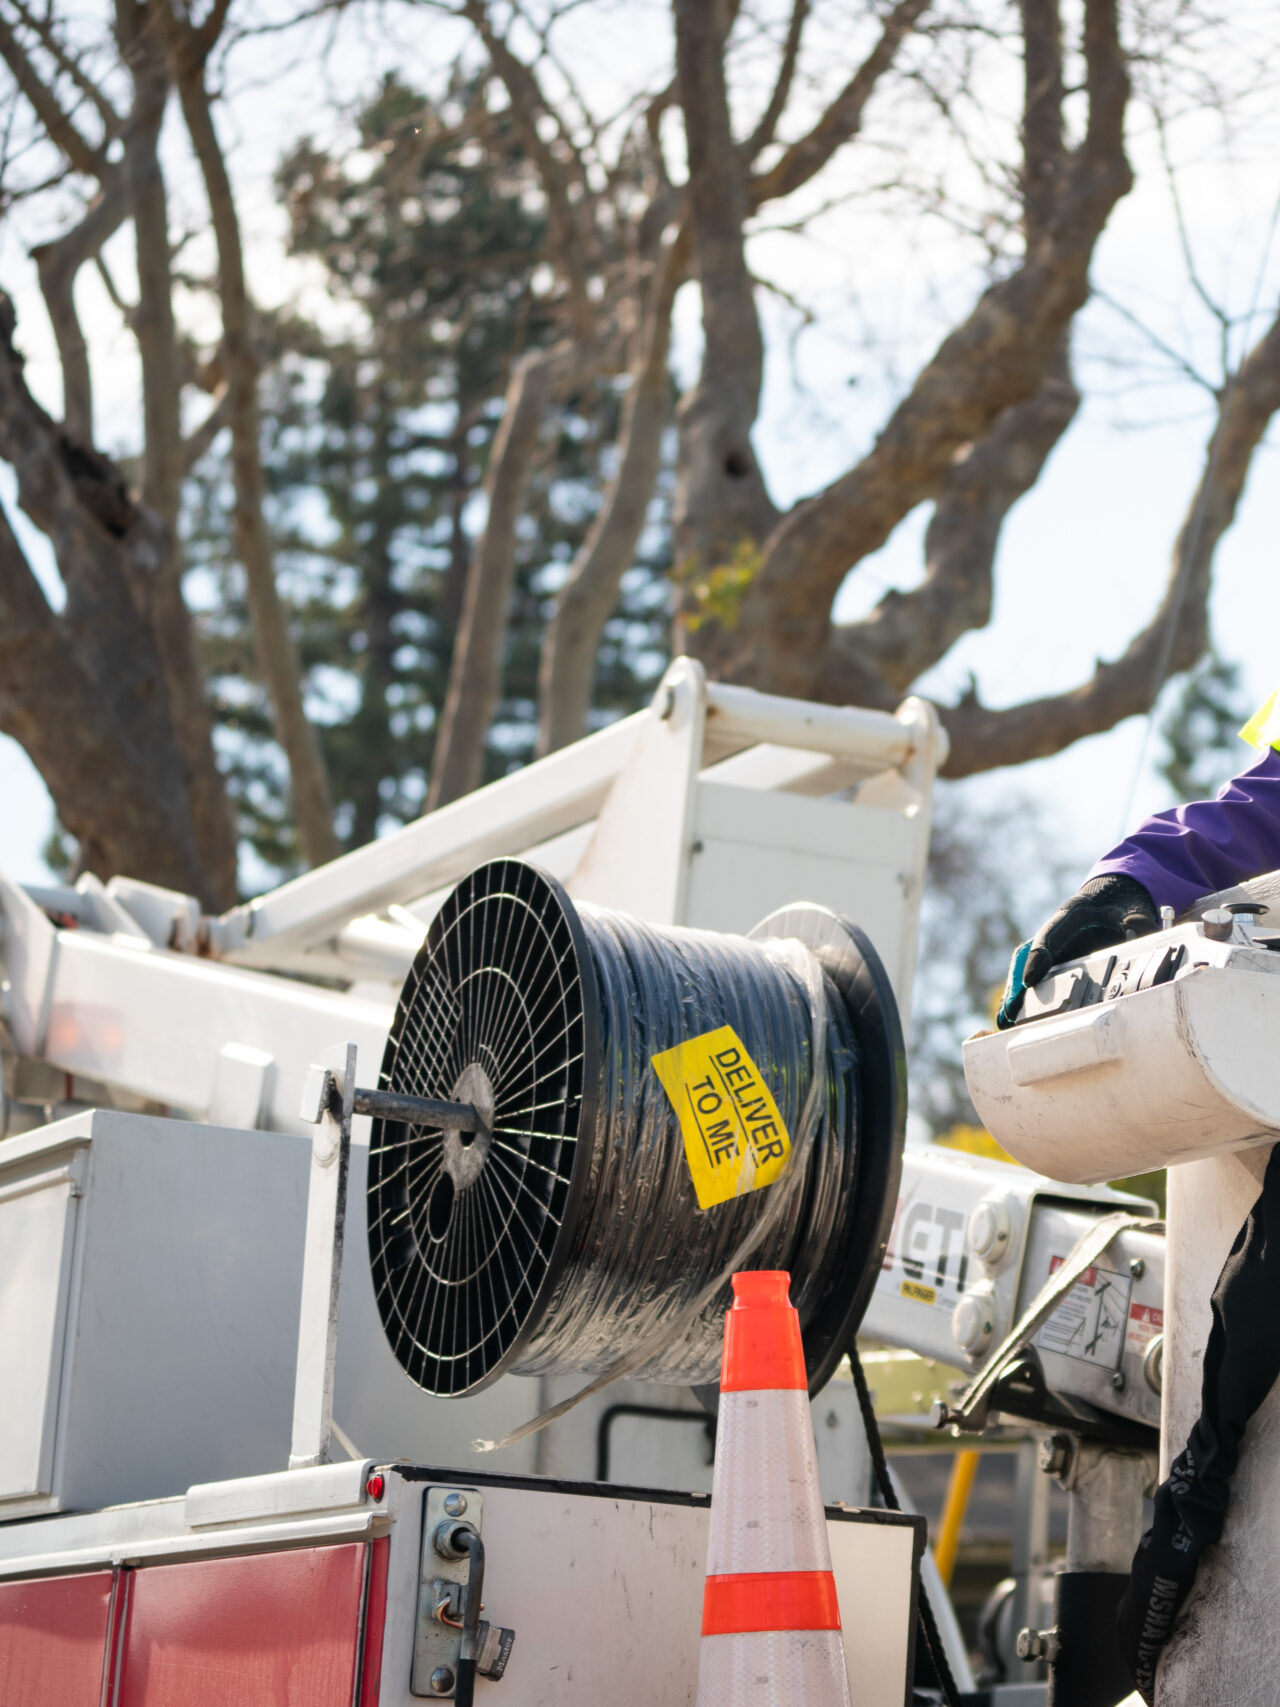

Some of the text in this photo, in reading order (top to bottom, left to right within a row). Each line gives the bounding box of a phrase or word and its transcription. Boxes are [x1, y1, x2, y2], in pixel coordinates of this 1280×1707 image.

[692, 1075, 741, 1166] TO ME
[715, 1047, 785, 1166] DELIVER
